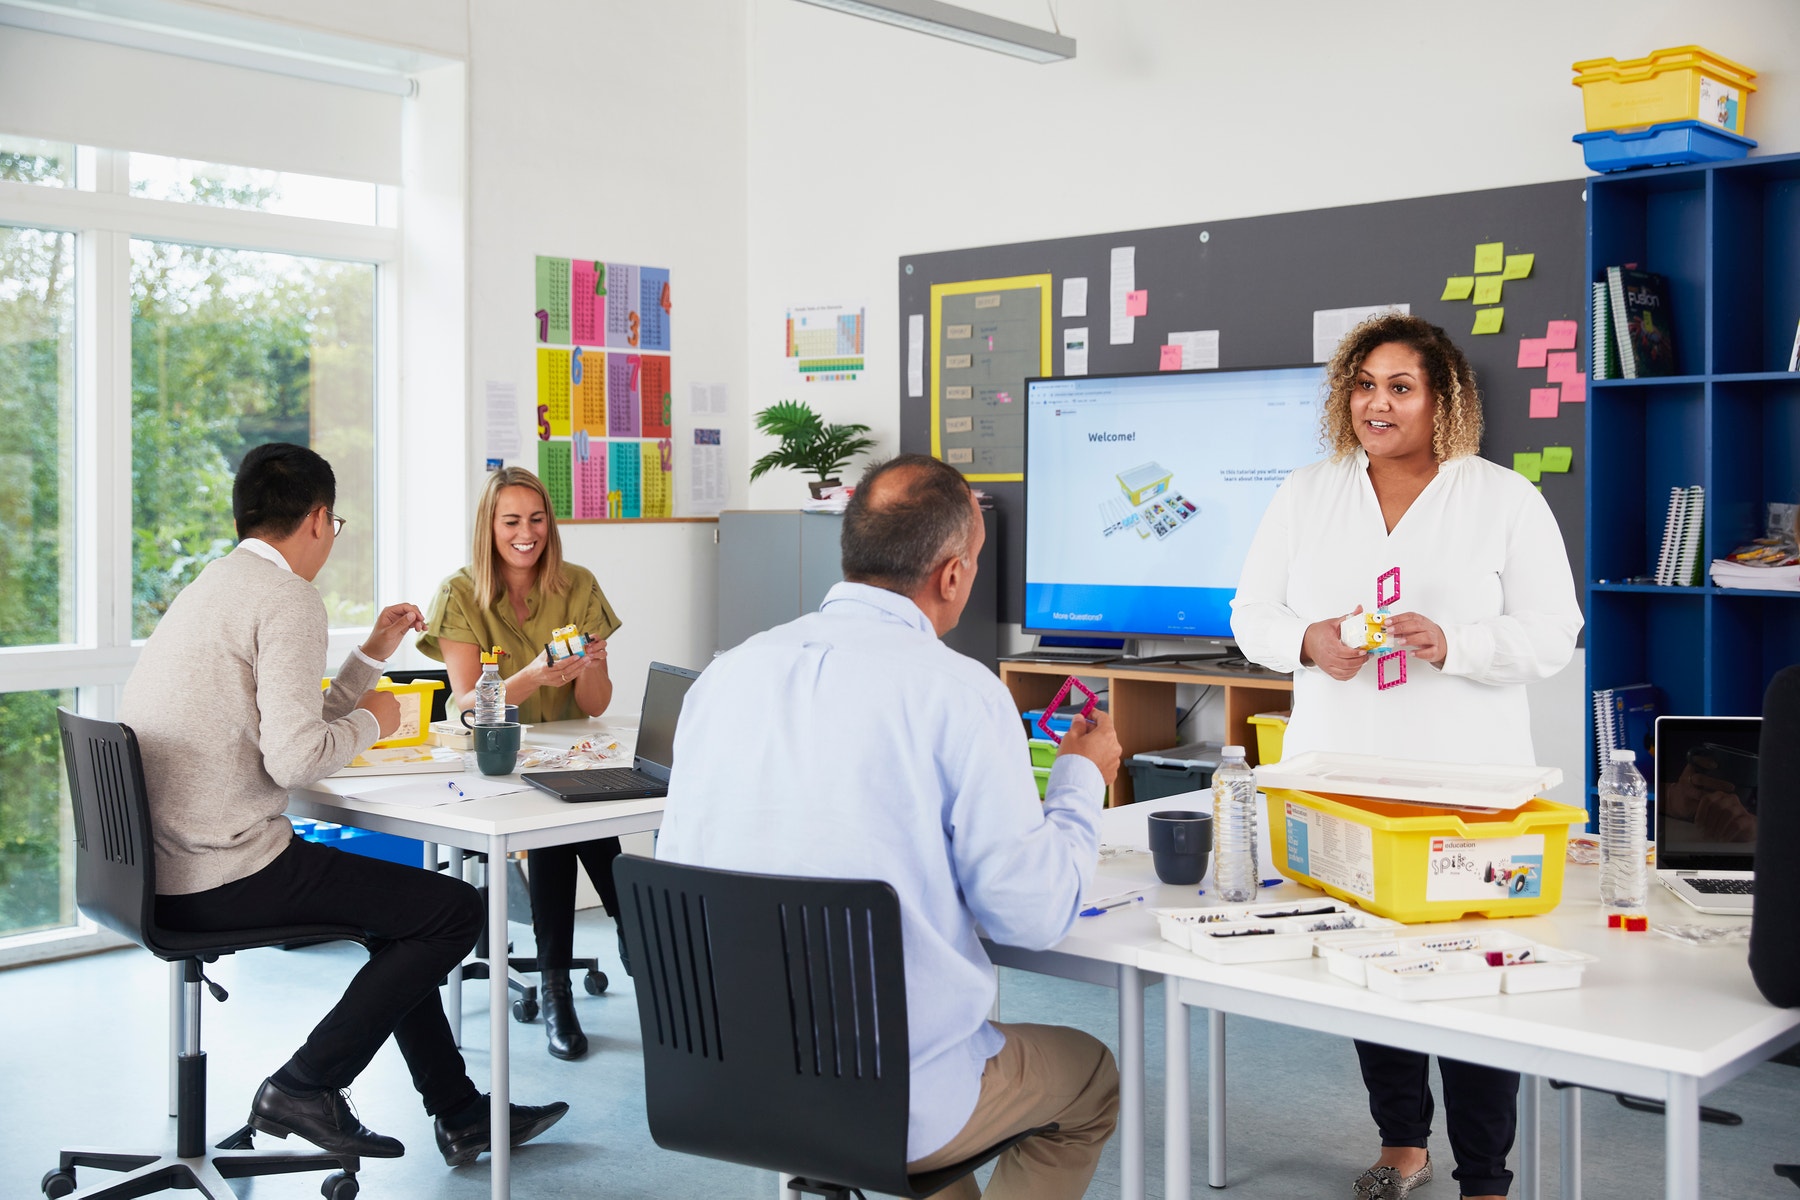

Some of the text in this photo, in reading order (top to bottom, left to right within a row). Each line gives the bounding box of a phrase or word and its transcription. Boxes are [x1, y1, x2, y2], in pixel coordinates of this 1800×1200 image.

[594, 260, 607, 296] 2
[660, 281, 672, 316] 4
[535, 309, 549, 343] 1
[627, 311, 639, 347] 3
[572, 346, 583, 385] 6
[626, 355, 641, 392] 7
[537, 404, 550, 441] 5
[662, 392, 671, 426] 8
[573, 429, 589, 463] 10
[1088, 432, 1136, 442] Welcome!
[657, 438, 672, 472] 12
[607, 489, 622, 519] 11
[1053, 612, 1103, 621] More Questions?
[1445, 841, 1476, 849] education
